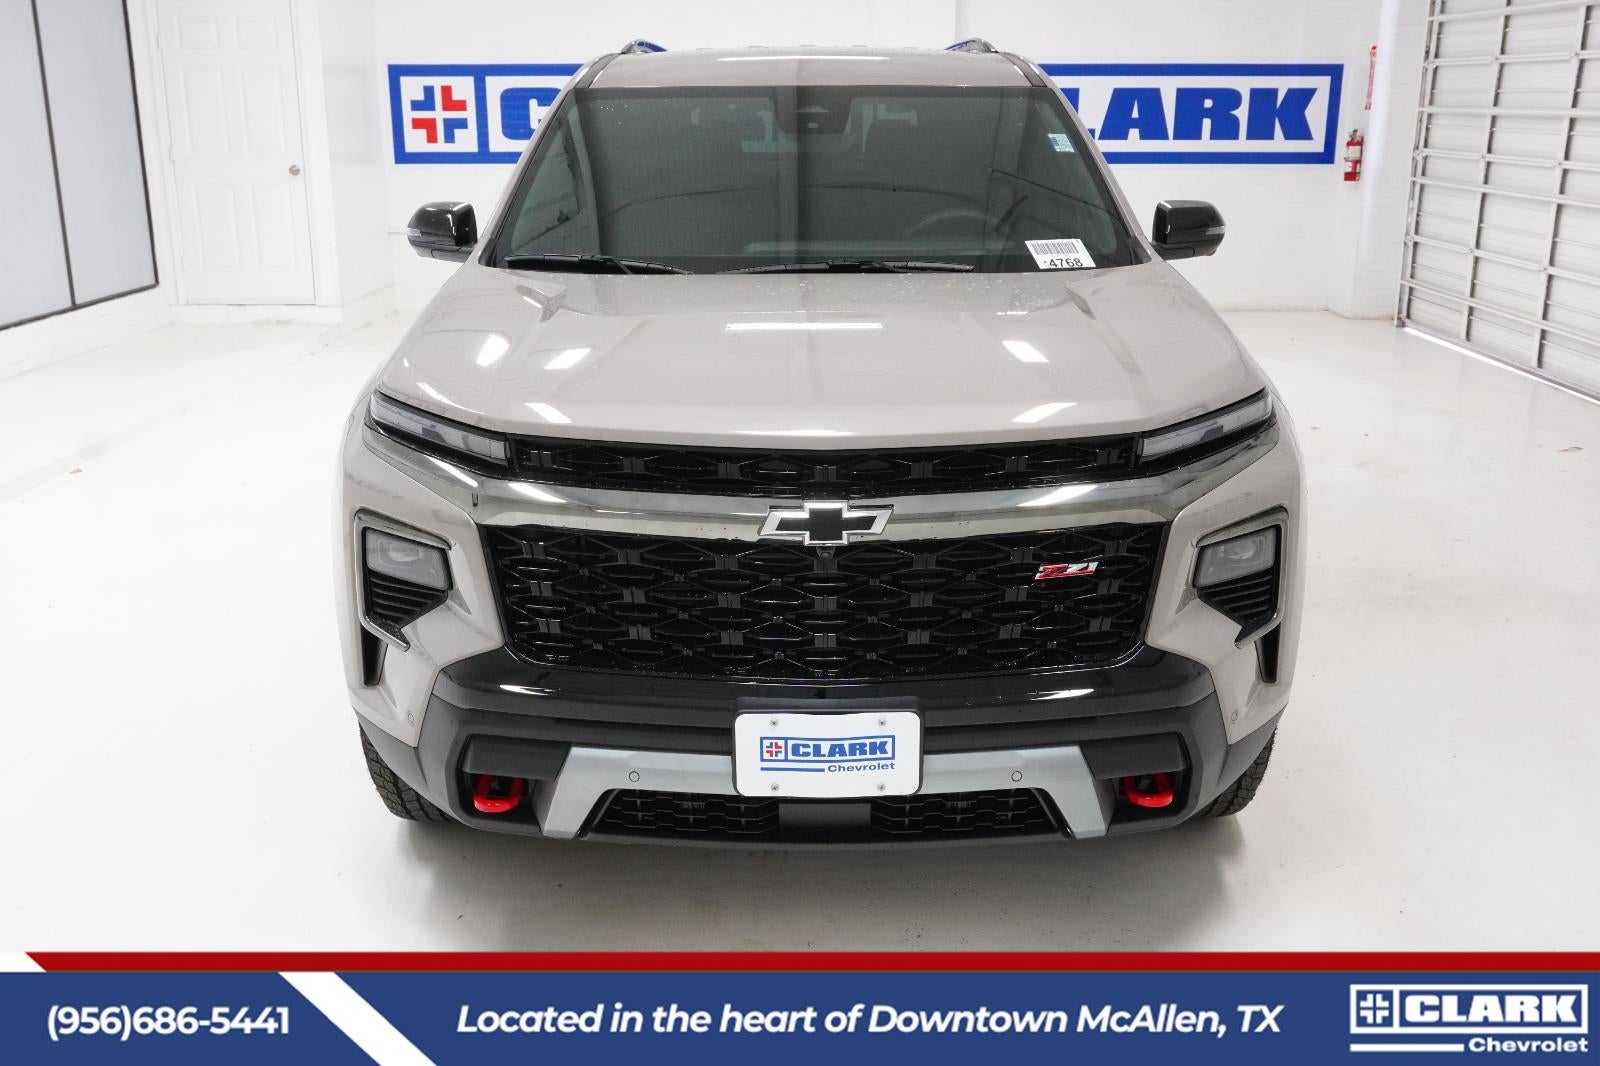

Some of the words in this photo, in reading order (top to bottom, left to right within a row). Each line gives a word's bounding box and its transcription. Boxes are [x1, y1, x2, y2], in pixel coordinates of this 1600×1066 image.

[1058, 87, 1319, 141] ARK
[1049, 258, 1084, 268] 4768
[791, 740, 889, 758] CLARK
[827, 762, 896, 773] Chevrolet
